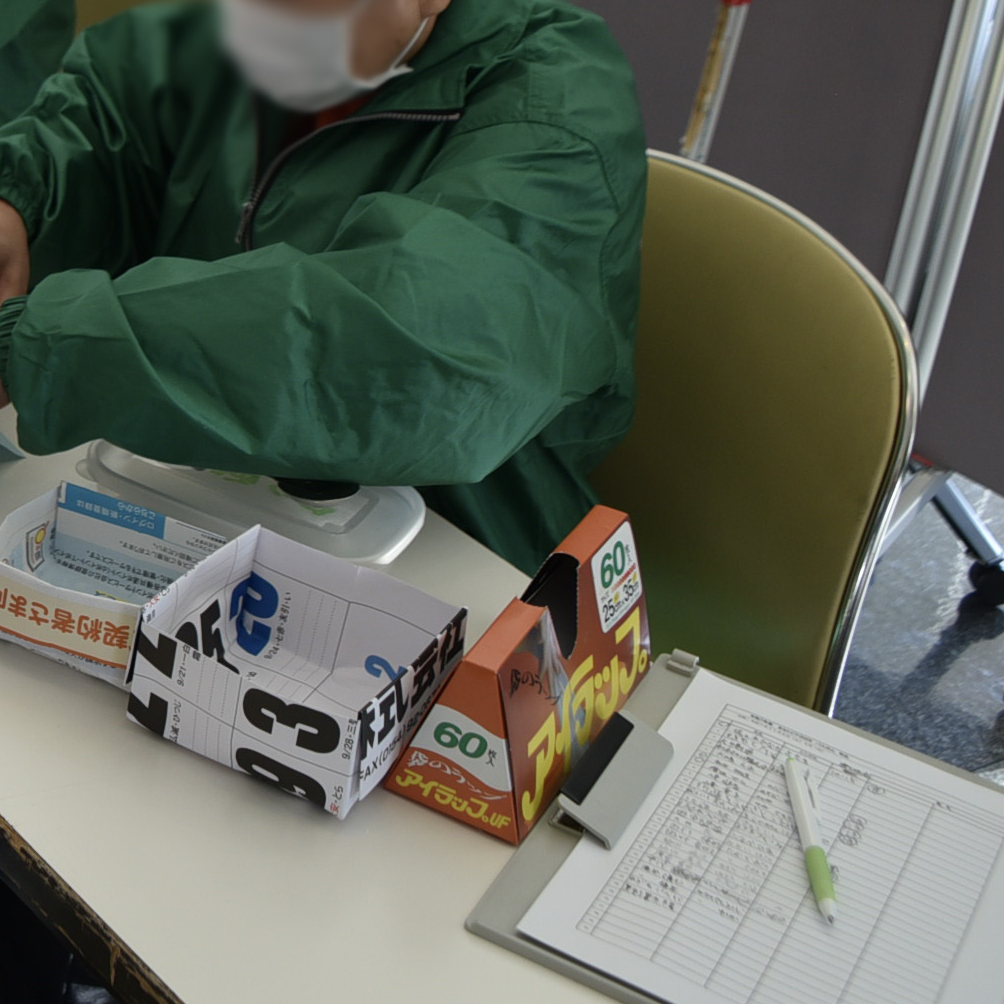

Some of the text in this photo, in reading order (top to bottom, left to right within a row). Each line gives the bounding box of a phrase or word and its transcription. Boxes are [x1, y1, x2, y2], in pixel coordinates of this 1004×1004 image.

[75, 498, 156, 531] ログイン・新規登録は
[116, 500, 157, 520] こちらから
[601, 540, 625, 589] 60
[433, 721, 488, 759] 60
